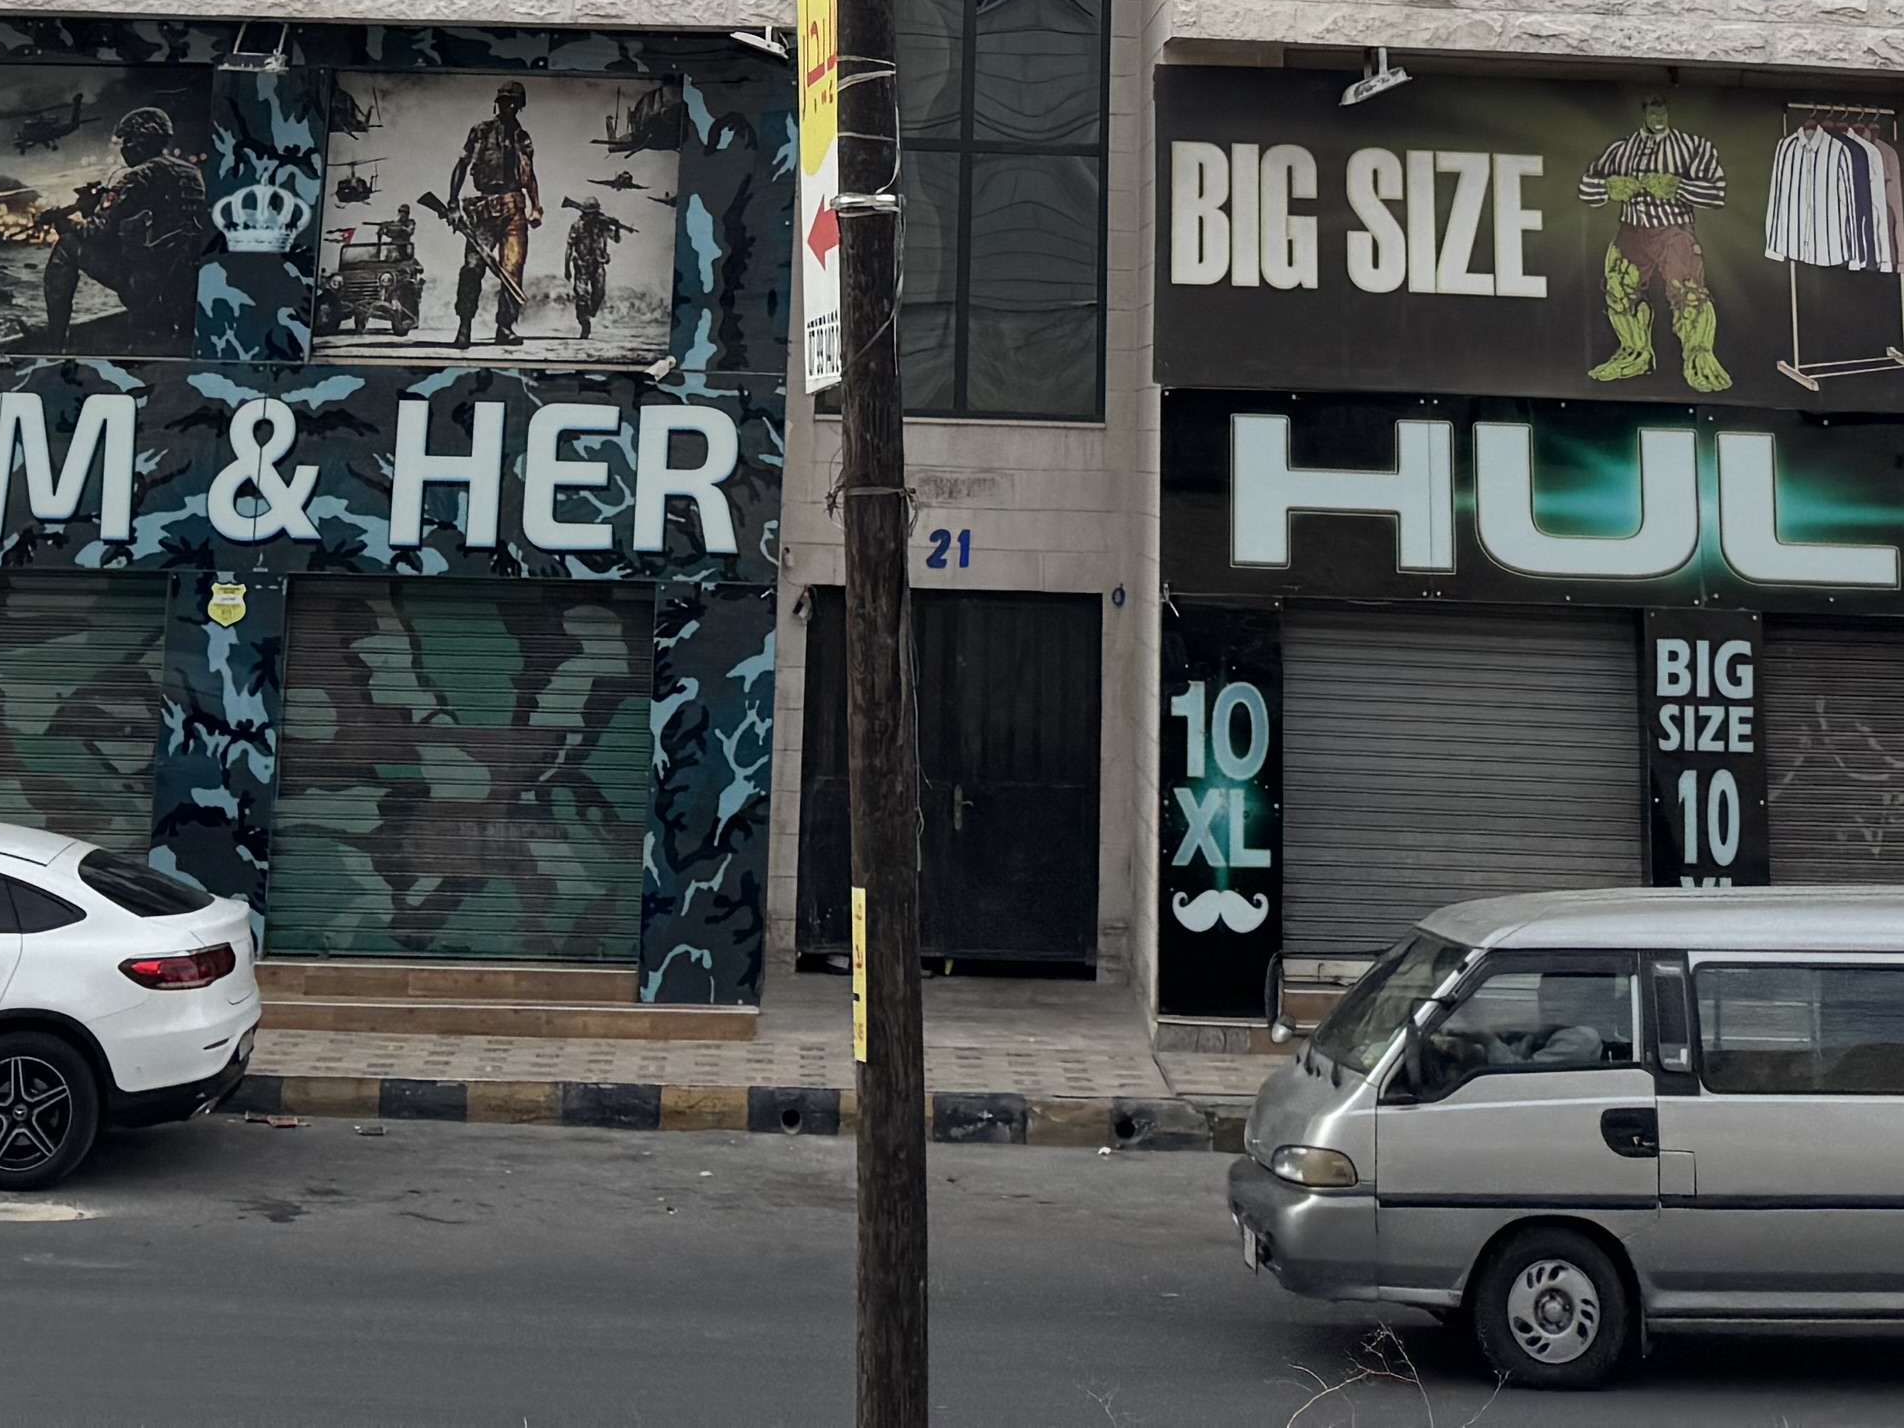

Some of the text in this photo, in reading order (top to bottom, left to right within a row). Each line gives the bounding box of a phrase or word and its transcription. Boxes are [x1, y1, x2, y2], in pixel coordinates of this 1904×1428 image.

[1171, 141, 1547, 298] BIG SIZE
[207, 395, 322, 543] &
[387, 398, 741, 555] HER
[926, 528, 971, 568] 21
[1656, 638, 1754, 699] BIG
[1171, 680, 1270, 780] 10
[1658, 704, 1754, 752] SIZE
[1171, 787, 1272, 868] XL
[1678, 768, 1741, 866] 10
